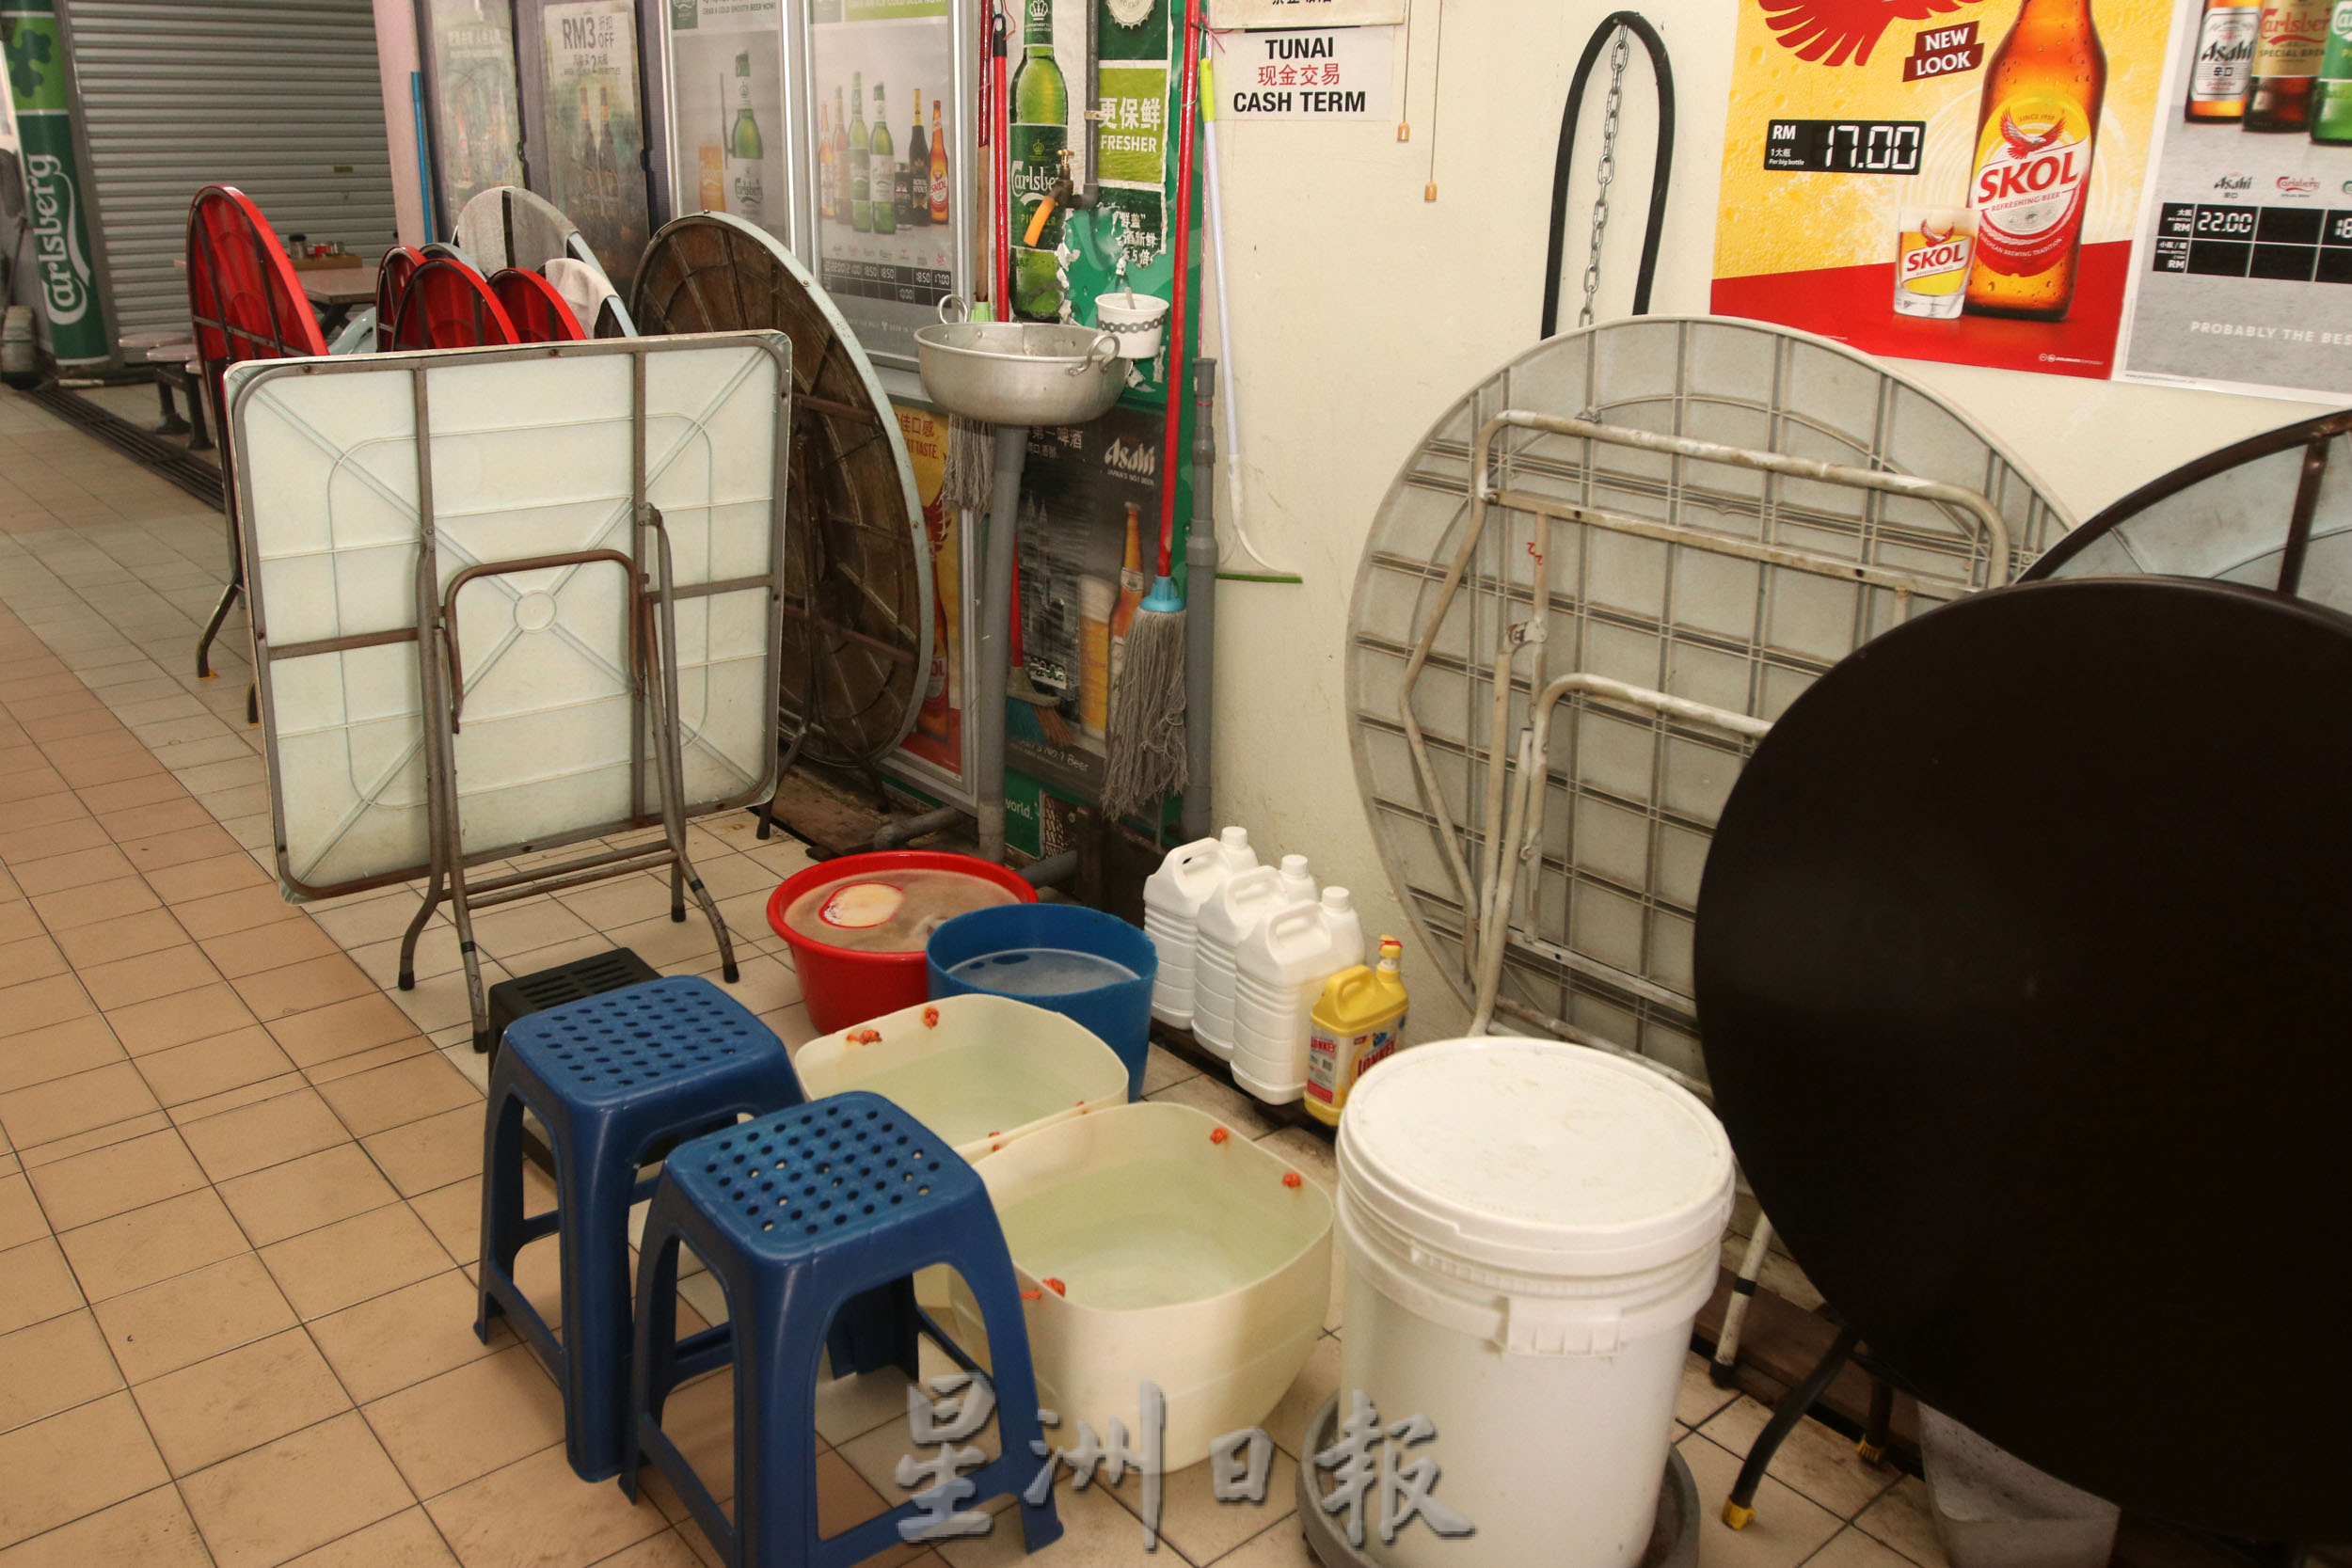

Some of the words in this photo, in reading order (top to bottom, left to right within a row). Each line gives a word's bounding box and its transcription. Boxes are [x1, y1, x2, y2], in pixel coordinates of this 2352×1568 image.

[562, 16, 596, 49] RM3
[2260, 8, 2332, 40] Carlsber
[597, 32, 614, 48] OFF
[1265, 37, 1334, 59] TUNAI
[1925, 26, 1969, 52] NEW
[2201, 40, 2255, 62] Asahi
[1916, 50, 1972, 76] LOOK
[1258, 63, 1341, 87] 现金交易
[1233, 92, 1292, 112] CASH
[1299, 91, 1366, 112] TERM
[1098, 97, 1162, 132] 更保鲜
[1100, 135, 1158, 152] FRESHER
[1772, 124, 1797, 140] RM
[1824, 125, 1920, 169] 17.00
[1778, 158, 1788, 166] big
[1788, 158, 1805, 166] bottle
[1011, 160, 1061, 198] Carlsbe
[1978, 150, 2079, 204] SKOL
[2214, 176, 2253, 190] Asahi
[2276, 176, 2320, 192] Carlsberg
[1991, 196, 2041, 212] REFRESHING
[2042, 191, 2061, 202] BEER
[2173, 222, 2191, 232] RM
[2197, 211, 2253, 233] 22.00
[26, 154, 91, 325] Carlsberg
[1906, 245, 1965, 272] SKOL
[2168, 260, 2185, 269] RM
[2190, 321, 2279, 340] PROBABLY
[2281, 328, 2315, 342] THE
[1104, 436, 1155, 476] Asahi
